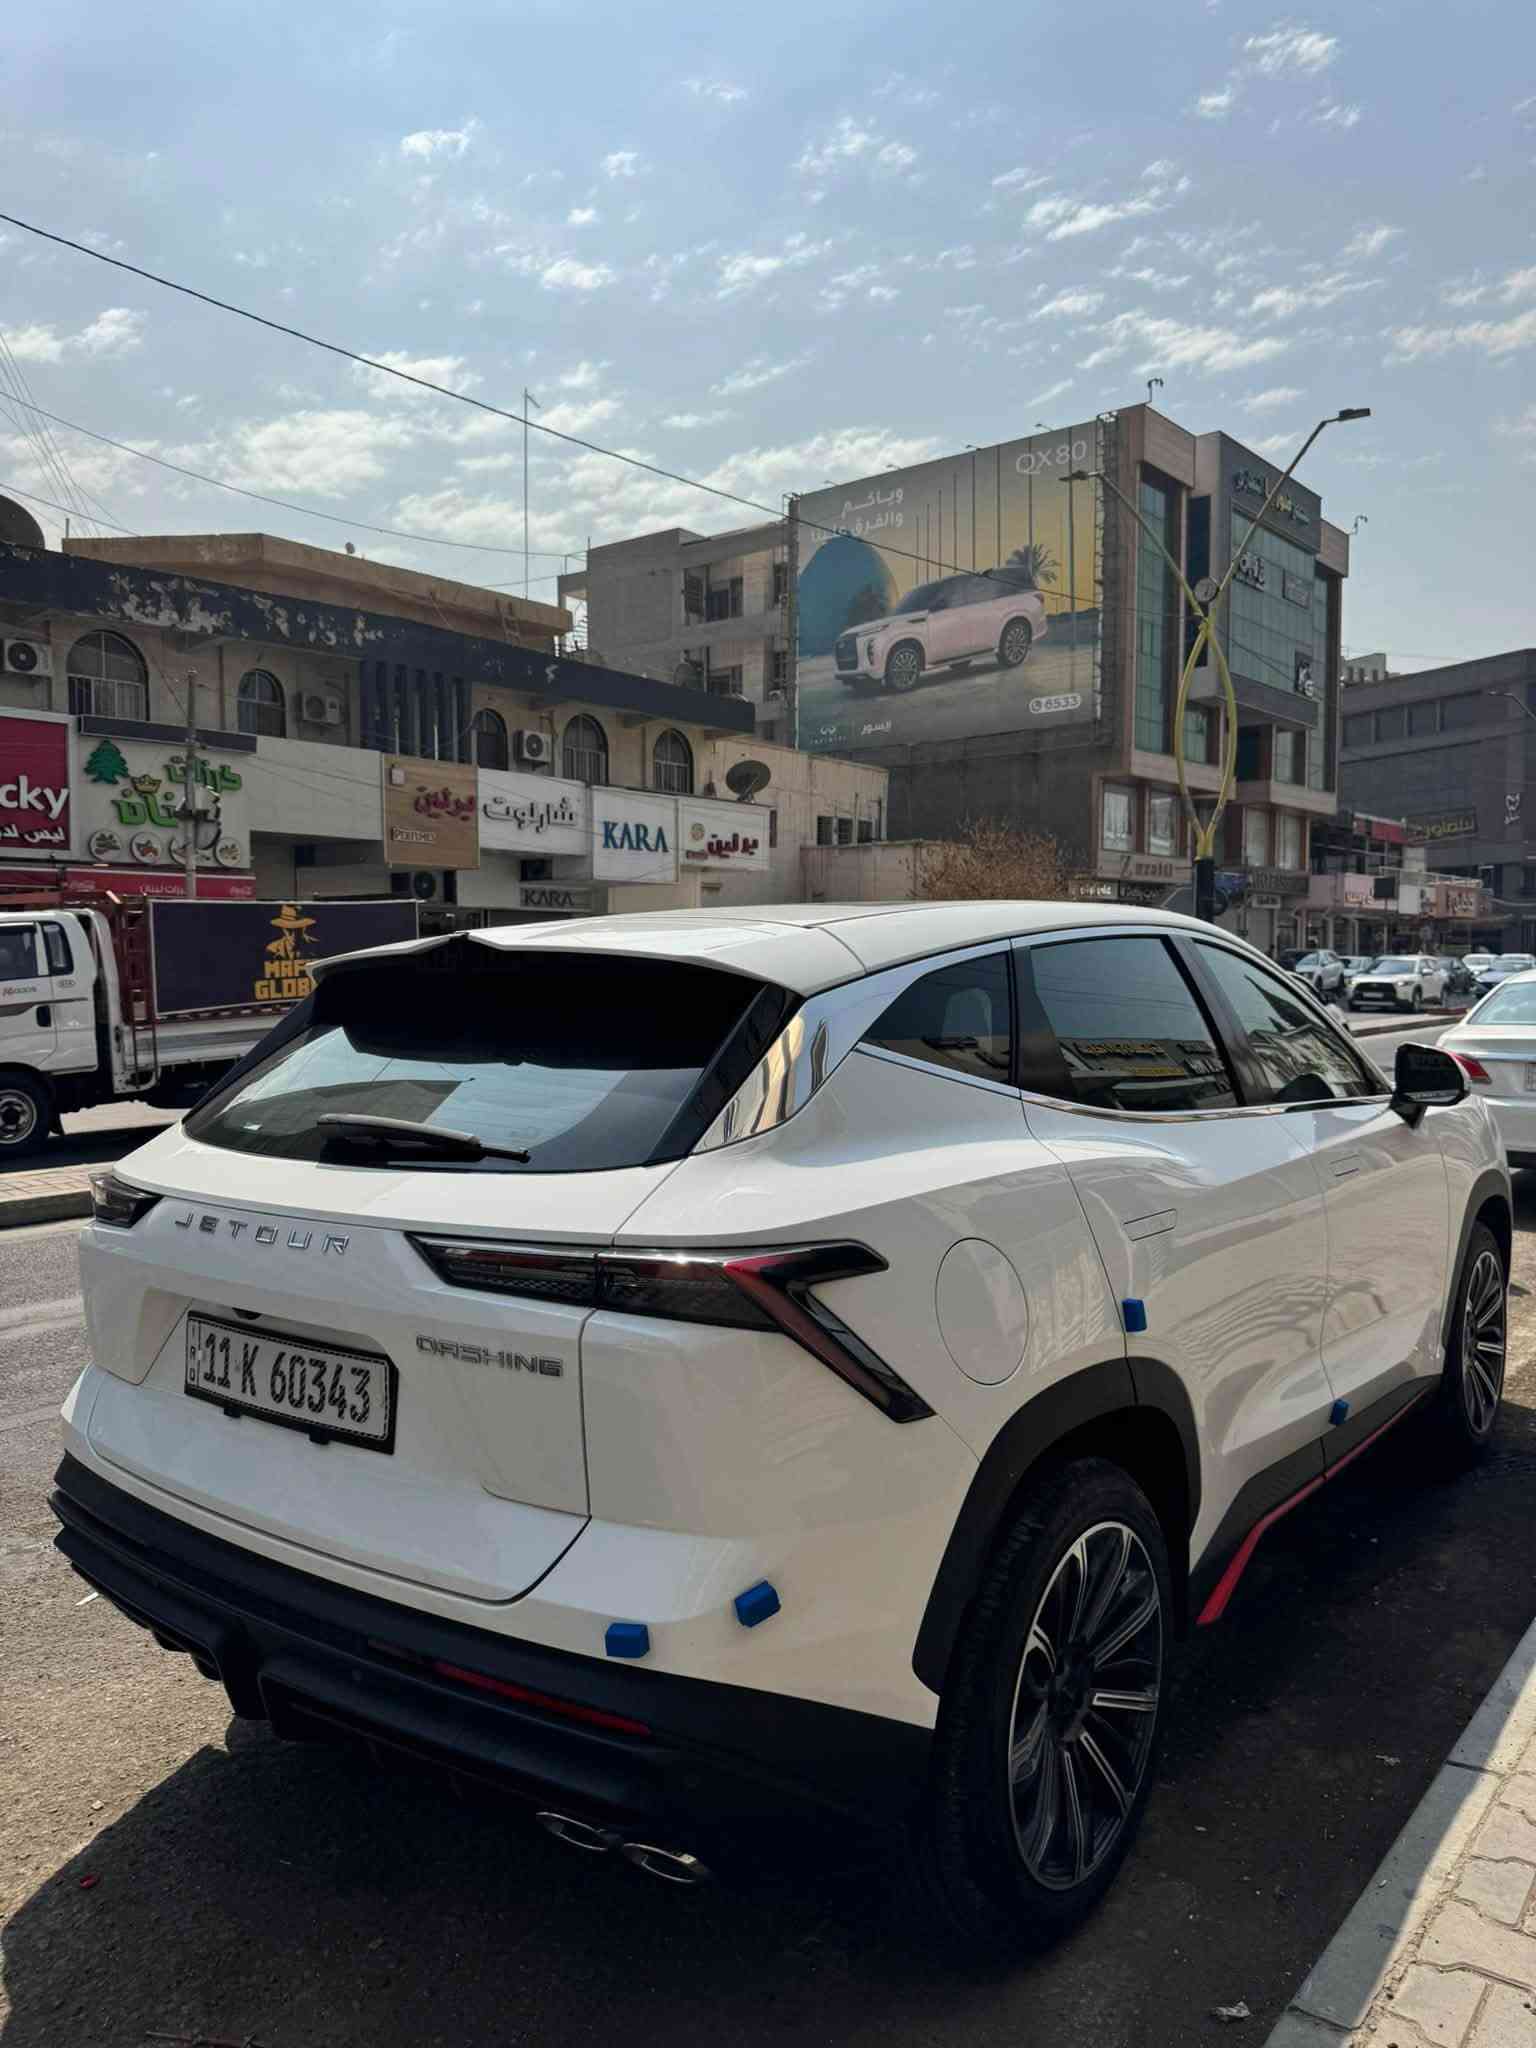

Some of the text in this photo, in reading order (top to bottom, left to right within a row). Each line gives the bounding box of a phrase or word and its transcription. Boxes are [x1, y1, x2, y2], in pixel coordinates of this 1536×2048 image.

[1016, 440, 1087, 474] QX80
[1045, 696, 1079, 710] 6533
[602, 821, 670, 853] KARA
[523, 889, 576, 907] KARA
[174, 1212, 351, 1254] JETOUR
[416, 1335, 564, 1377] DASHING
[203, 1334, 372, 1423] 11 K 60343
